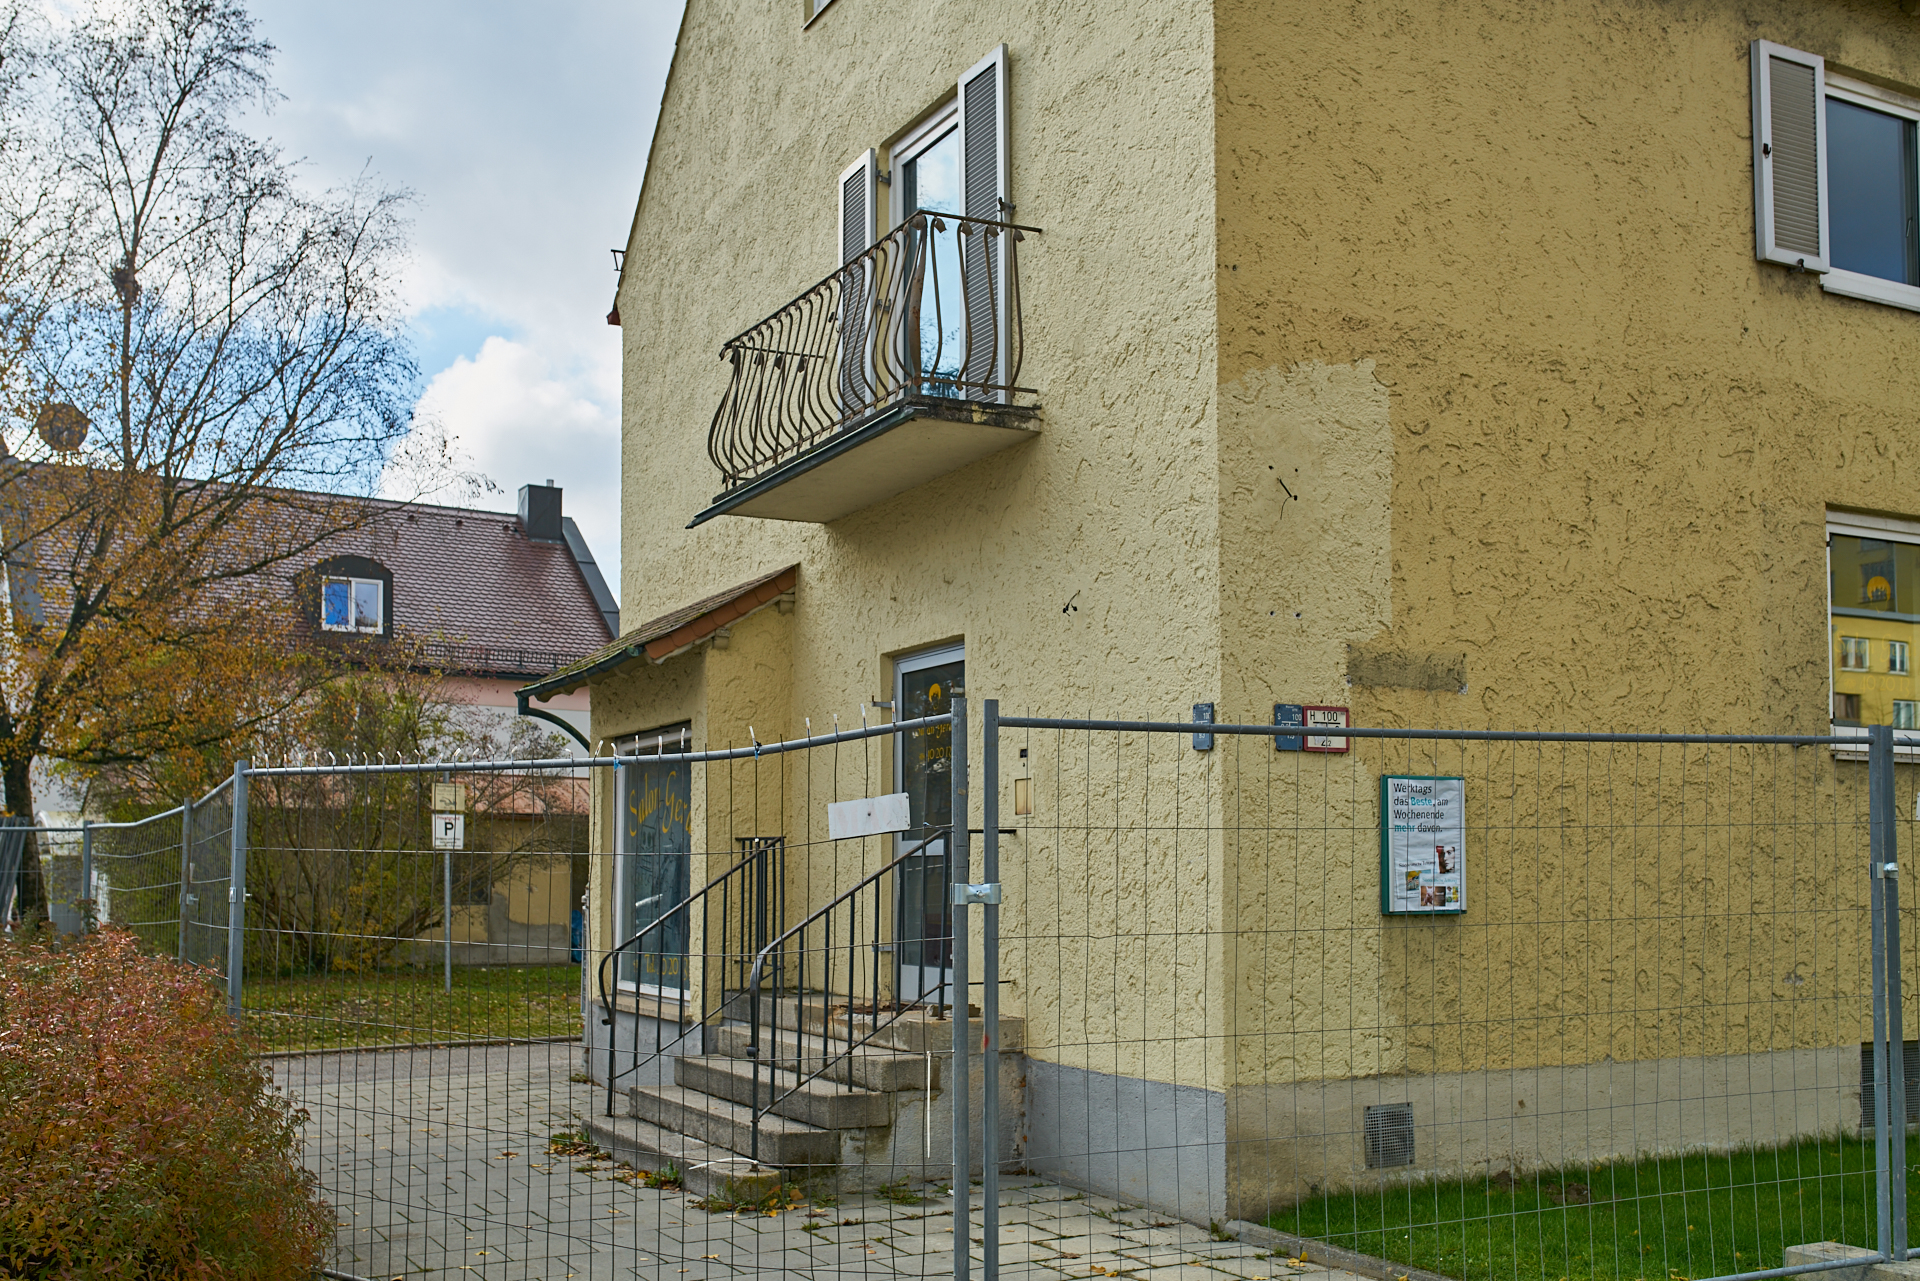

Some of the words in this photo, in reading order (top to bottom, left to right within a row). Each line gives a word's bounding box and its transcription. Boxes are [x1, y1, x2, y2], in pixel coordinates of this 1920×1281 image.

[1879, 675, 1896, 691] 20
[1309, 710, 1316, 721] H
[1322, 711, 1338, 722] 100
[1393, 783, 1432, 795] Werktags
[1393, 796, 1409, 806] das
[1410, 796, 1436, 807] Beste,
[1393, 809, 1445, 820] Wochenende
[444, 821, 454, 837] P
[1394, 822, 1416, 833] mehr
